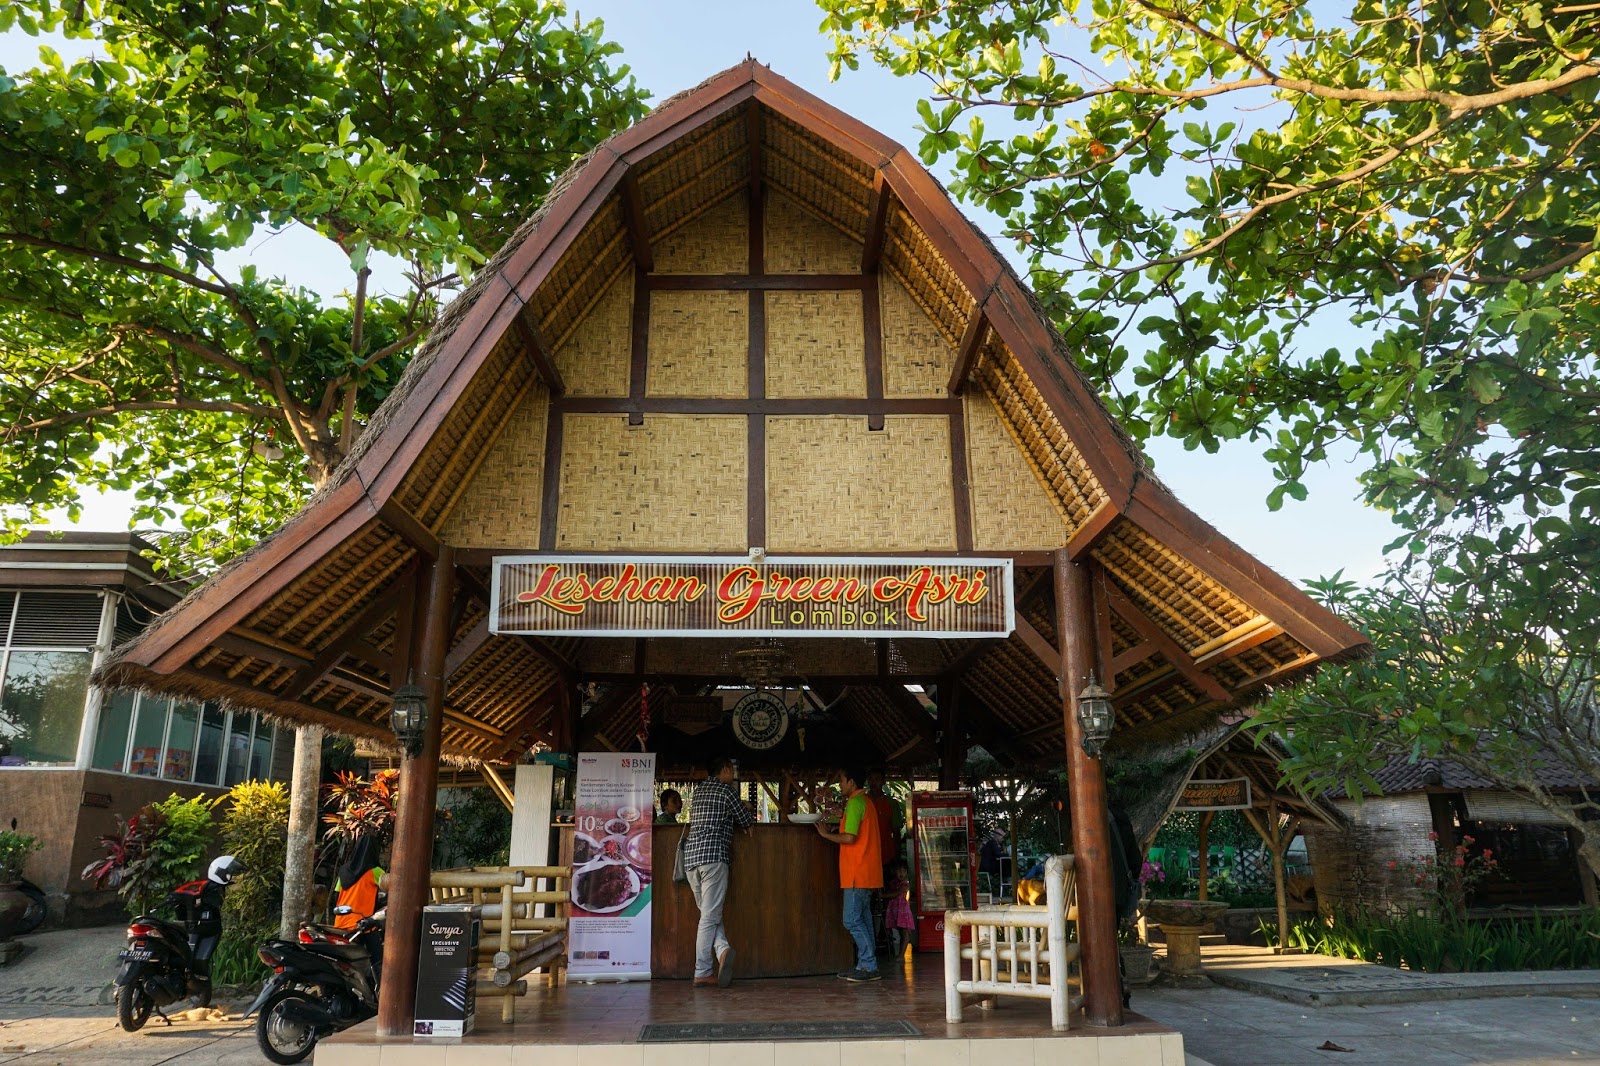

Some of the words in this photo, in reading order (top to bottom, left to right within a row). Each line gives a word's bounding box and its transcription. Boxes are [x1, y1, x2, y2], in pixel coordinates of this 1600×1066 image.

[517, 563, 706, 614] Lesehan
[718, 566, 867, 623] Green
[872, 566, 989, 622] Asri
[770, 606, 898, 625] Lombok
[734, 693, 760, 716] MAJELIS
[767, 695, 786, 716] ULAMA
[737, 733, 782, 748] INDONESIA
[632, 759, 651, 768] BNI
[429, 923, 463, 939] Surya
